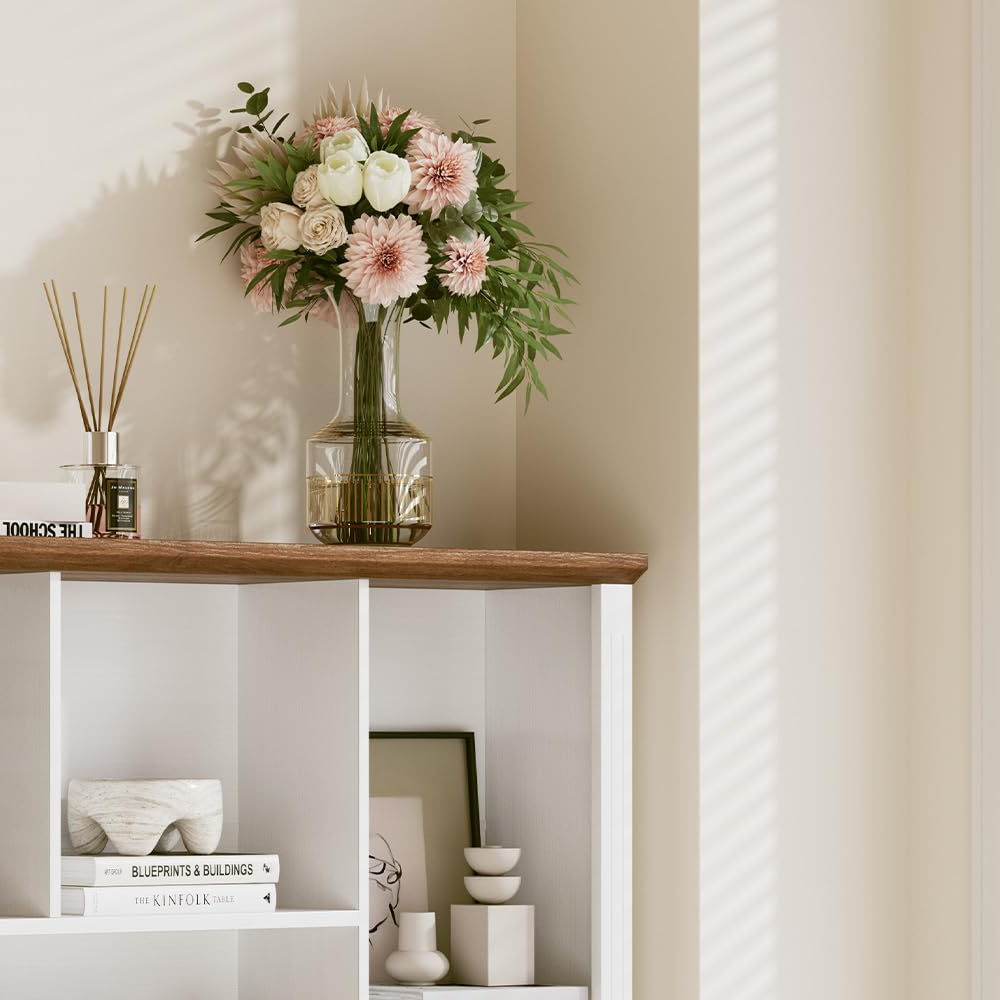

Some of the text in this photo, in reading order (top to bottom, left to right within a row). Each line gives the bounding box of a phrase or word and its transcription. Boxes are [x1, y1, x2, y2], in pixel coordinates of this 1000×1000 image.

[3, 522, 56, 538] SCHOOL
[132, 864, 191, 878] BLUEPRINTS
[194, 864, 200, 876] &
[203, 863, 254, 876] BUILDINGS
[135, 896, 150, 904] THE
[153, 892, 212, 907] KINFOLK
